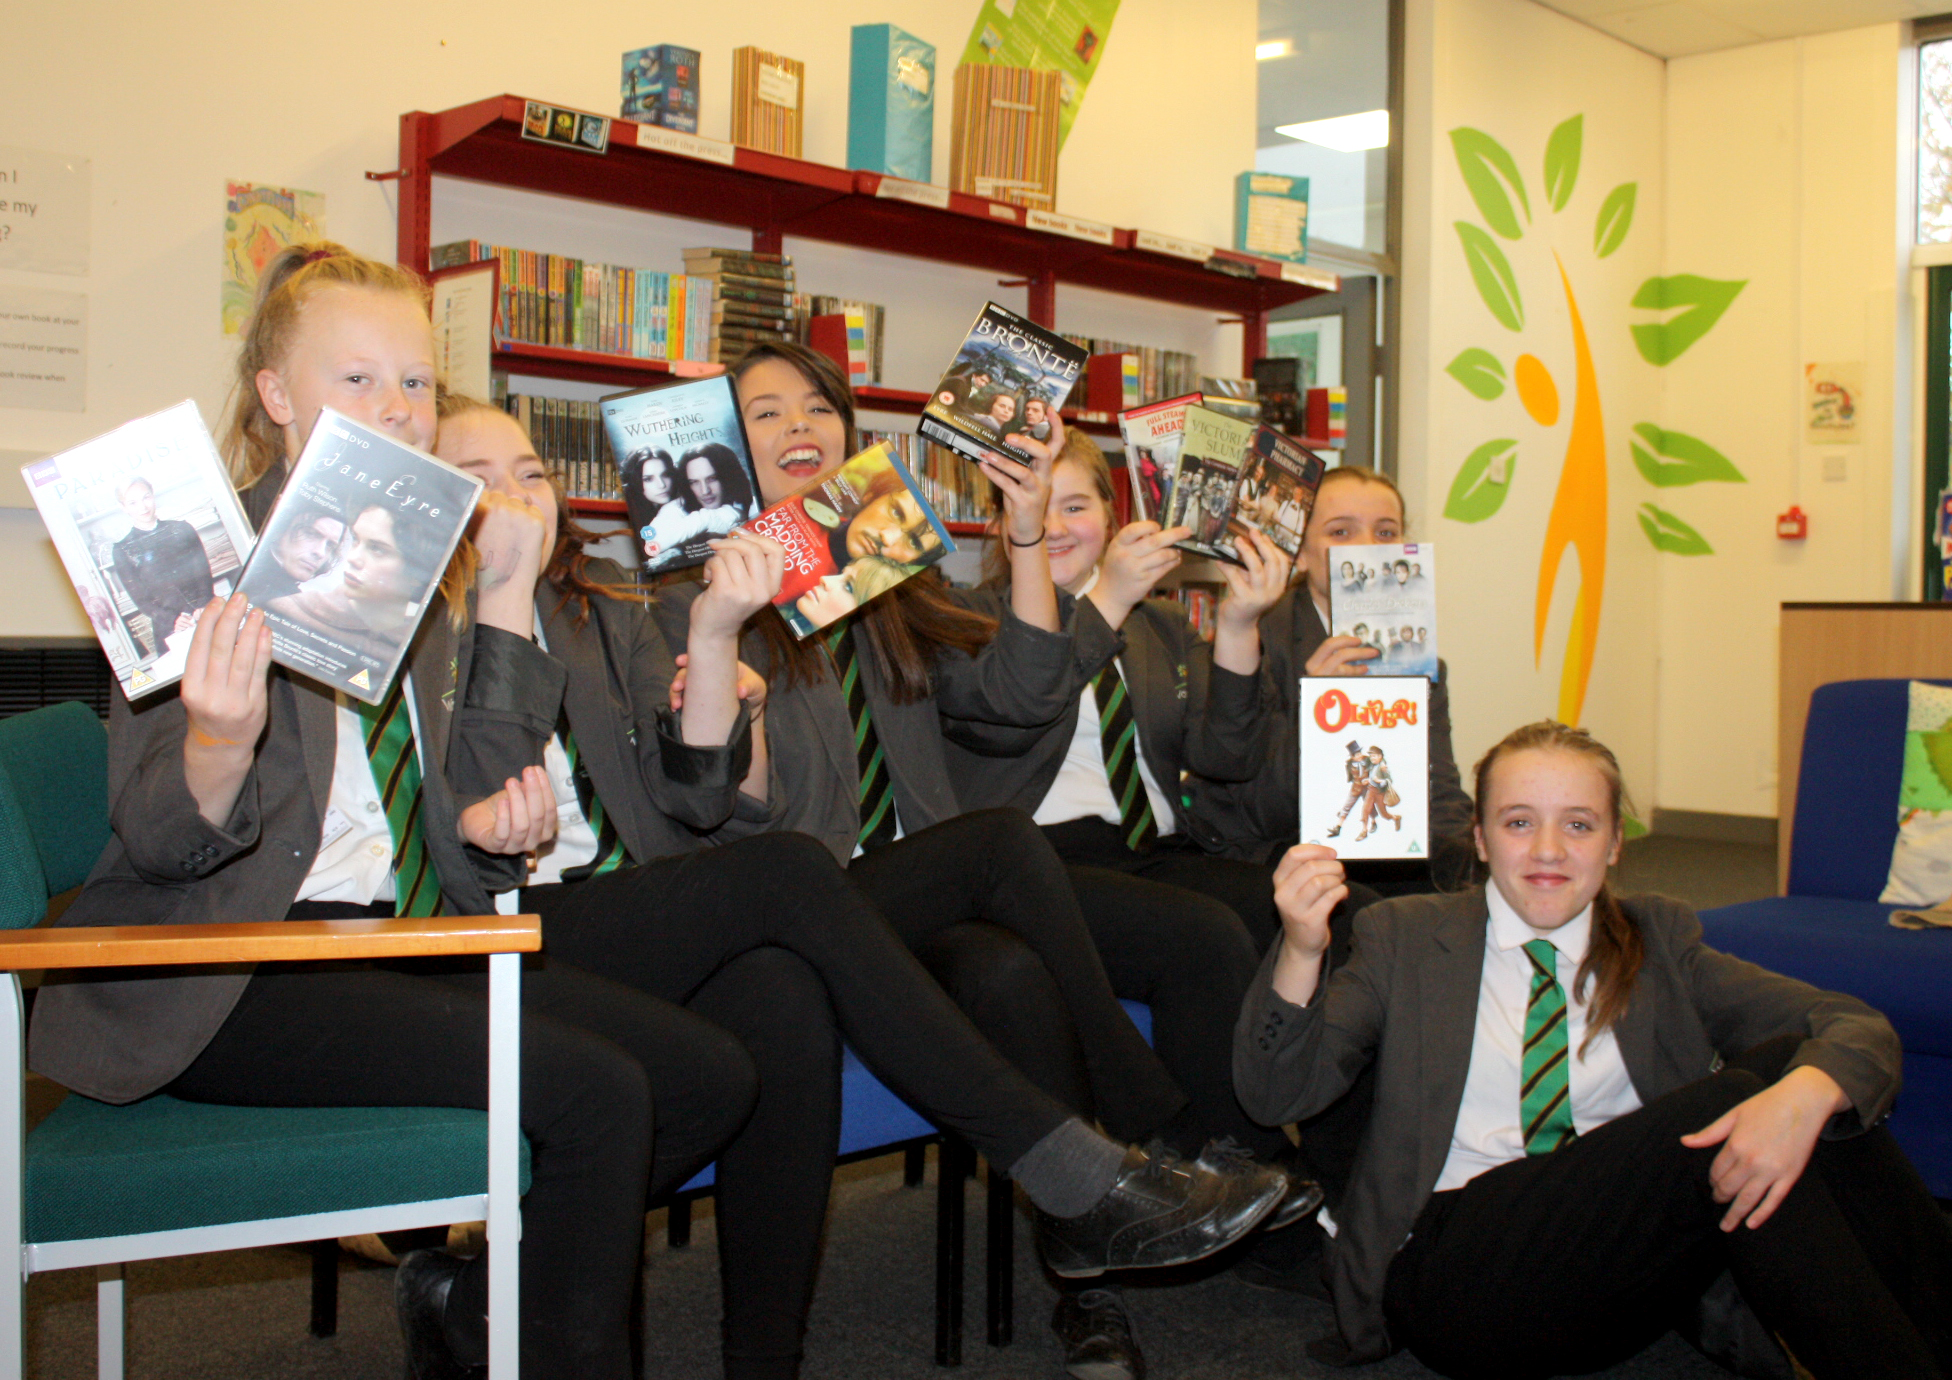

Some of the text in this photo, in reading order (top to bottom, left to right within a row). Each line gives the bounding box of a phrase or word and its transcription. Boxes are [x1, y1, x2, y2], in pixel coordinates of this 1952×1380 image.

[670, 55, 695, 67] ROTH
[643, 133, 662, 145] Hot
[663, 137, 681, 147] off
[681, 140, 695, 151] the
[13, 201, 37, 217] my
[1032, 214, 1047, 226] New
[32, 314, 51, 323] book
[1009, 324, 1054, 350] THE CLASSIC
[976, 317, 1079, 381] BRONTË
[624, 413, 704, 438] WUTHERING
[953, 414, 983, 435] WILDFELL
[981, 430, 998, 443] HALL
[1146, 410, 1186, 427] FULL STEAM
[1151, 420, 1184, 437] AHEAD
[349, 434, 370, 449] DVD
[1191, 419, 1249, 446] VICTORIA
[1002, 440, 1029, 459] HEIGHTS
[1274, 439, 1307, 464] VICTORIAN
[53, 437, 189, 500] PARADISE
[302, 481, 338, 503] Ruth Wilson
[314, 442, 441, 519] Jane Eyre
[298, 488, 342, 513] Toby Stephens
[644, 530, 653, 538] 15
[754, 520, 795, 571] CRD
[765, 512, 814, 575] MADDING
[776, 507, 822, 567] FAR FROM THE
[134, 675, 147, 685] PG
[357, 676, 368, 685] PG
[1314, 689, 1418, 733] OLIVER!
